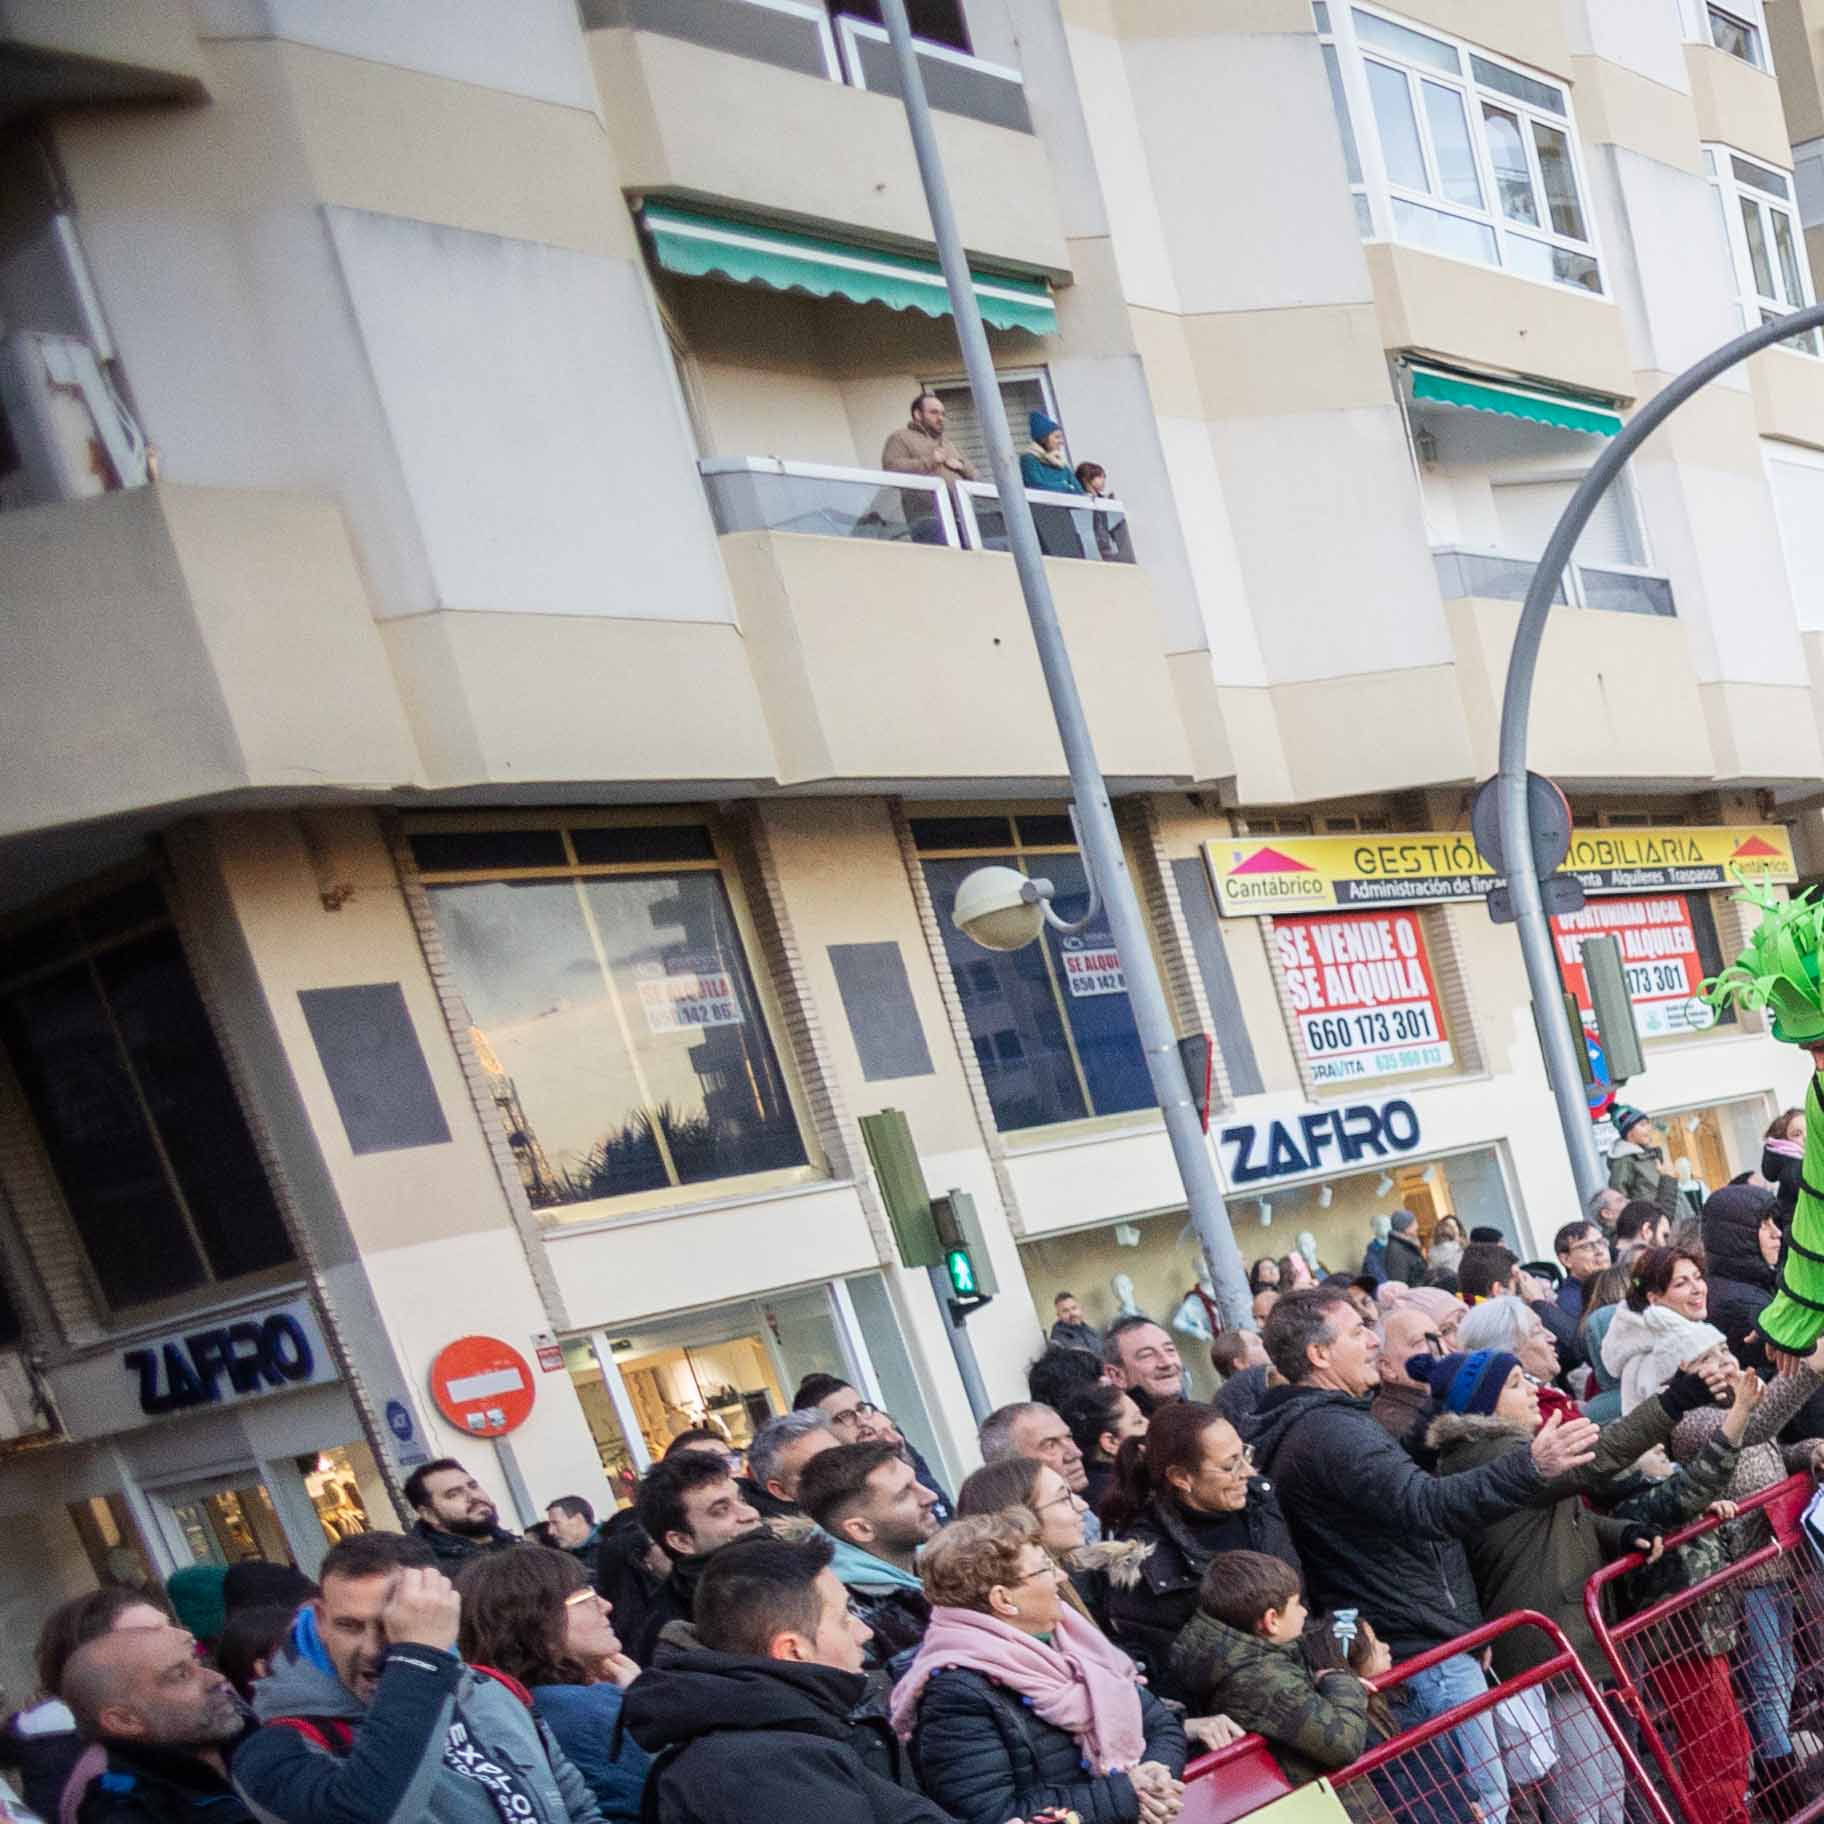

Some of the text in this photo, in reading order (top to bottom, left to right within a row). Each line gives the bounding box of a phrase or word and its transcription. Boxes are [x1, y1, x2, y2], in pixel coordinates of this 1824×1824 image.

[1225, 876, 1323, 899] Cantábrico
[1350, 876, 1450, 899] Administración
[1453, 877, 1471, 894] de
[1611, 869, 1665, 888] Alquileres
[1667, 867, 1720, 884] Traspasos
[1646, 899, 1685, 923] LOCAL
[1275, 917, 1419, 968] SE VENDE O
[1067, 956, 1083, 973] SE
[1656, 964, 1685, 990] 301
[1285, 959, 1430, 1010] SE ALQUILA
[1307, 1007, 1432, 1051] 660 173 301
[1221, 1098, 1422, 1184] ZAFIRO
[124, 1311, 316, 1417] ZAFIRO
